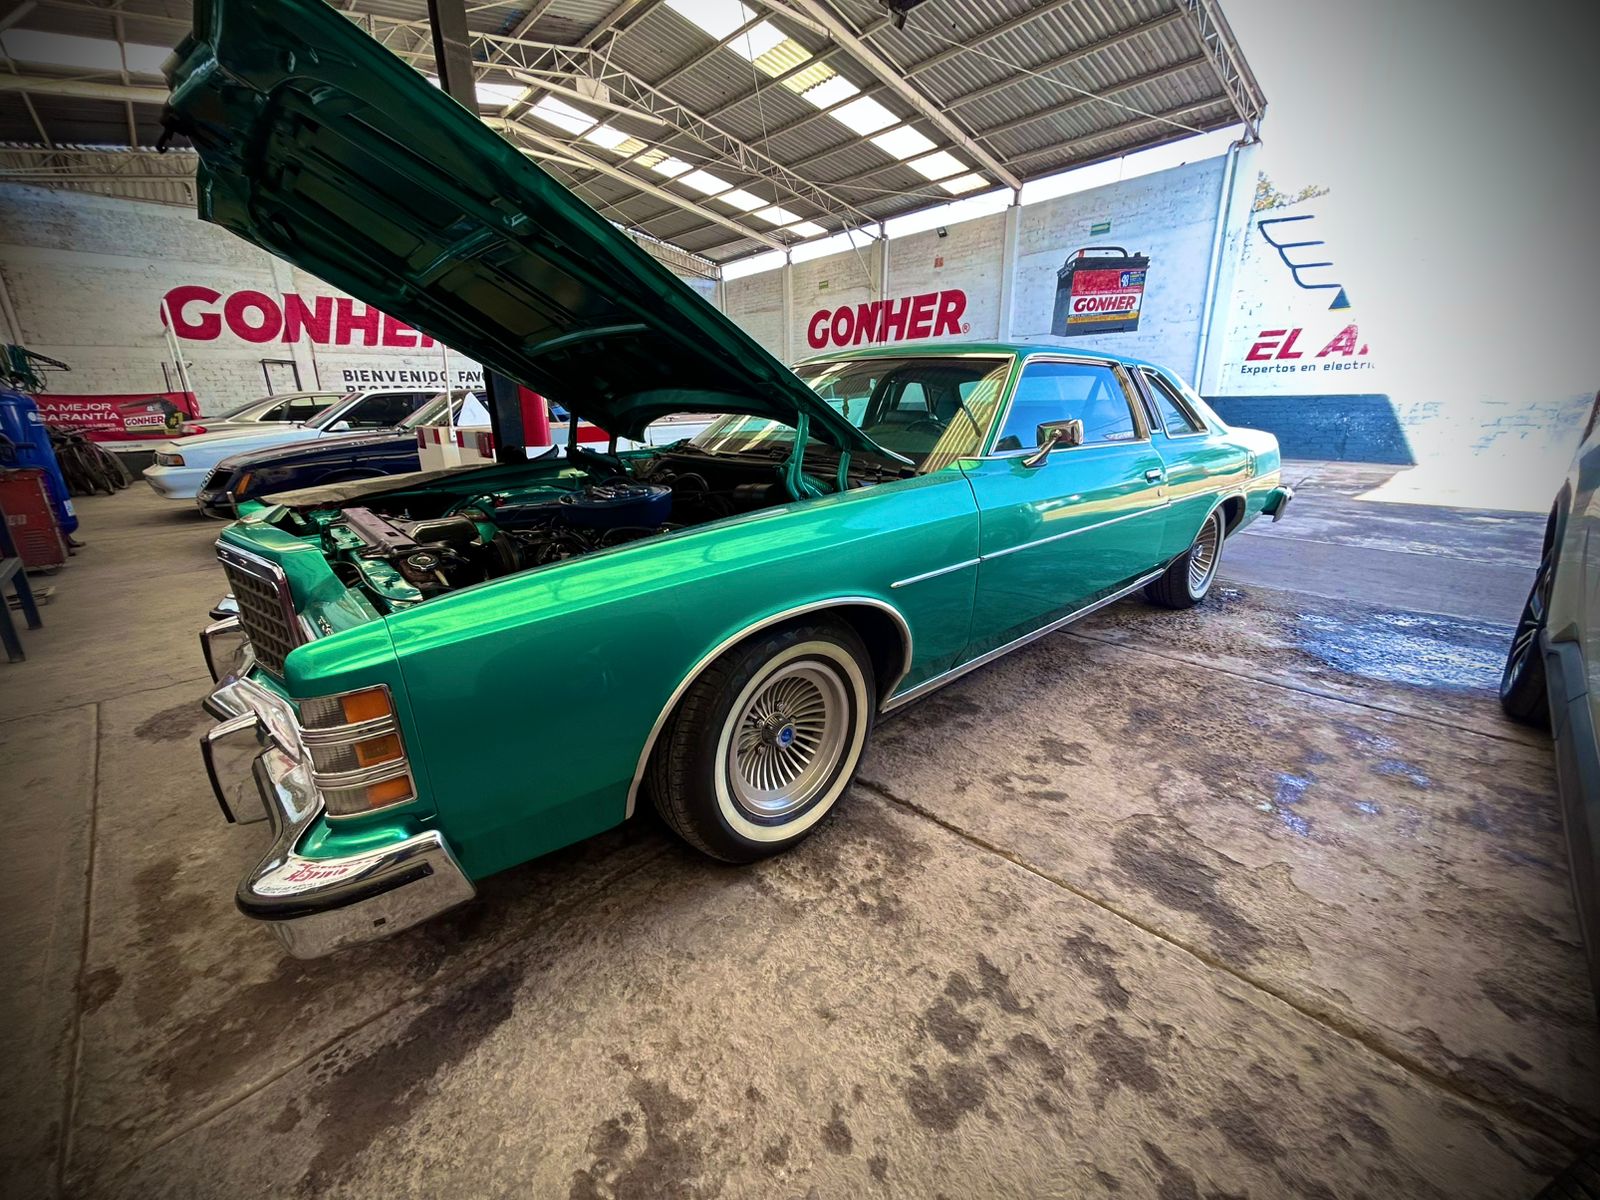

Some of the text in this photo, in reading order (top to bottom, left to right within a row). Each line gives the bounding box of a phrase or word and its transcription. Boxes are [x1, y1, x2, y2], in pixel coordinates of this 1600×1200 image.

[1073, 296, 1137, 313] GONHER
[160, 285, 445, 348] GONHE
[807, 289, 967, 349] GONHER
[1245, 324, 1369, 361] EL A
[458, 370, 486, 383] FAV
[1240, 364, 1296, 376] Expertos
[1300, 363, 1316, 372] en
[36, 402, 112, 412] LA MEJOR
[125, 415, 165, 426] GONHER
